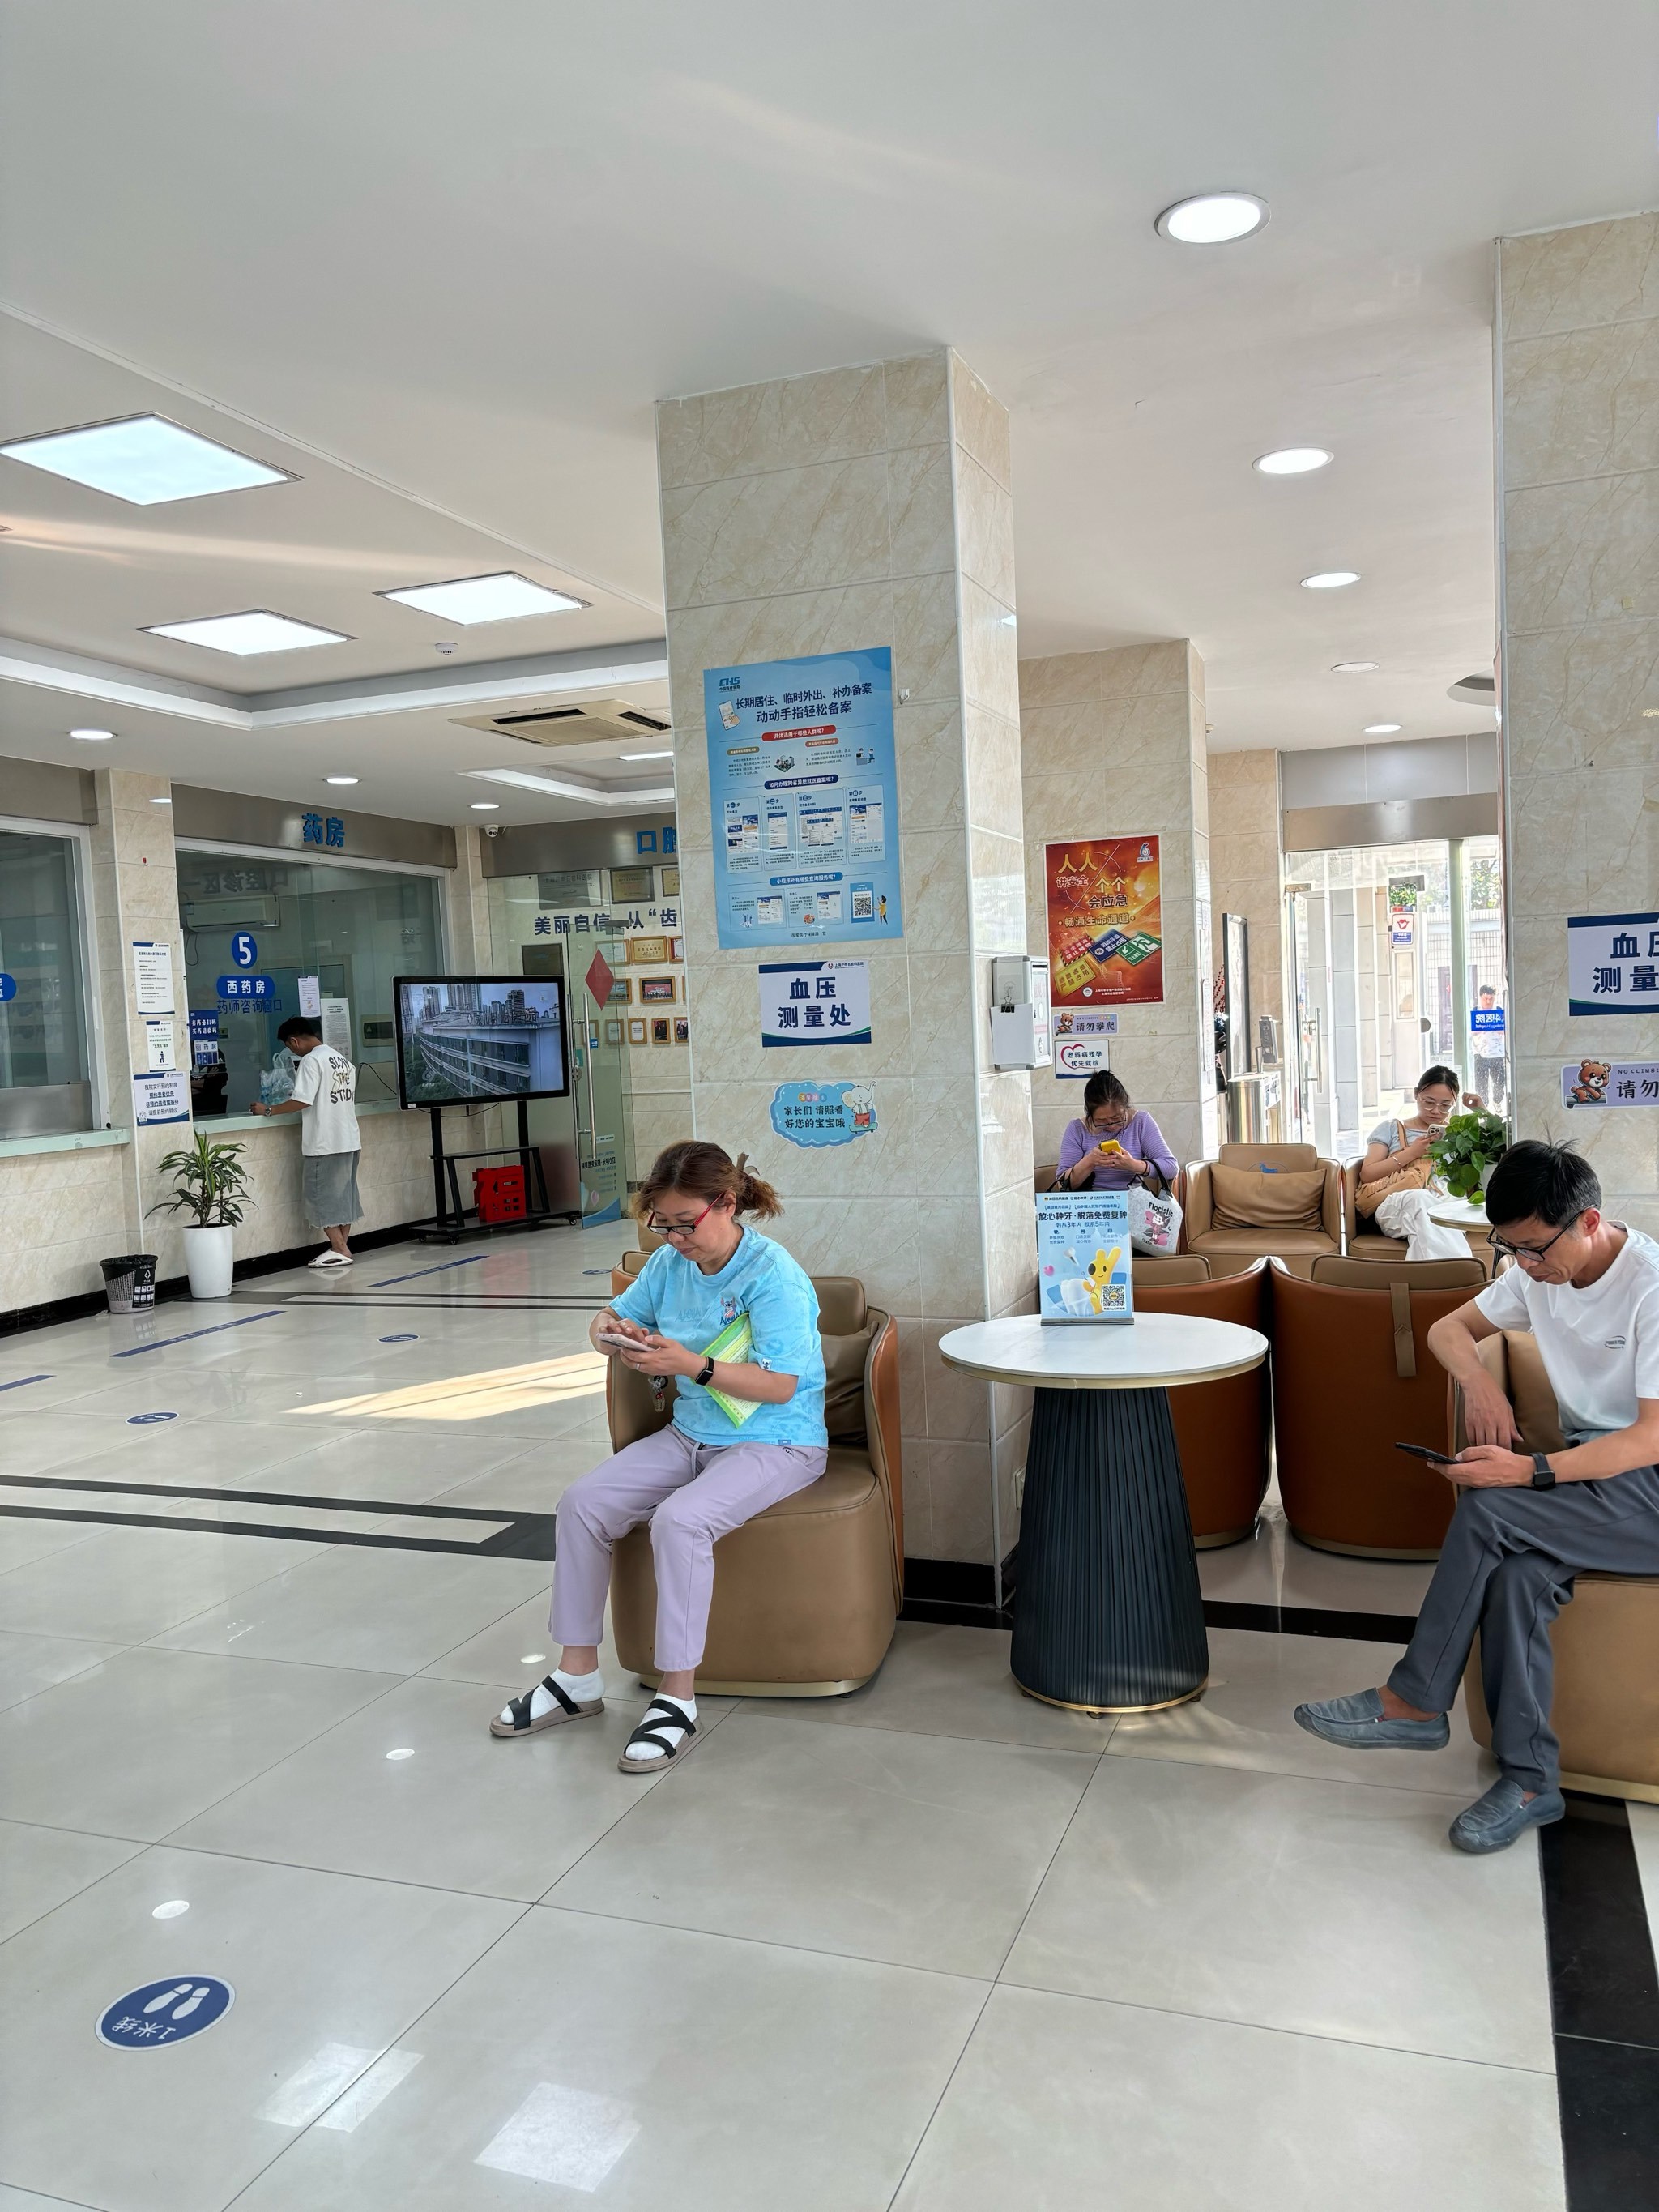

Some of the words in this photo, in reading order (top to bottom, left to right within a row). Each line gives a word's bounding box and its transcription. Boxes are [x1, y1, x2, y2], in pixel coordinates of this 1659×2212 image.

[719, 677, 740, 686] CHS
[736, 683, 872, 710] 长期居住、临时外出、补办备案
[756, 700, 852, 723] 动动手指轻松备案
[302, 813, 346, 848] 药房
[1057, 852, 1098, 874] 人人
[1056, 876, 1089, 888] 讲安全
[1094, 876, 1126, 893] 个个
[1088, 895, 1128, 909] 会应急
[534, 913, 610, 936] 美丽自信
[1064, 912, 1131, 928] 畅通生命通道
[238, 937, 252, 965] 5
[227, 980, 266, 994] 西药房
[789, 977, 837, 1000] 血压
[1593, 965, 1659, 994] 测量
[216, 999, 283, 1014] 药师咨询窗口
[778, 1004, 851, 1028] 测量处
[1076, 1021, 1115, 1031] 请勿攀爬
[1616, 1078, 1659, 1099] 请勿
[783, 1106, 812, 1116] 家长们
[815, 1105, 843, 1115] 请照看
[784, 1117, 846, 1129] 好您的宝宝哦
[1038, 1211, 1128, 1221] 放心种牙·脱落免费复种
[111, 2016, 177, 2039] 1米线
